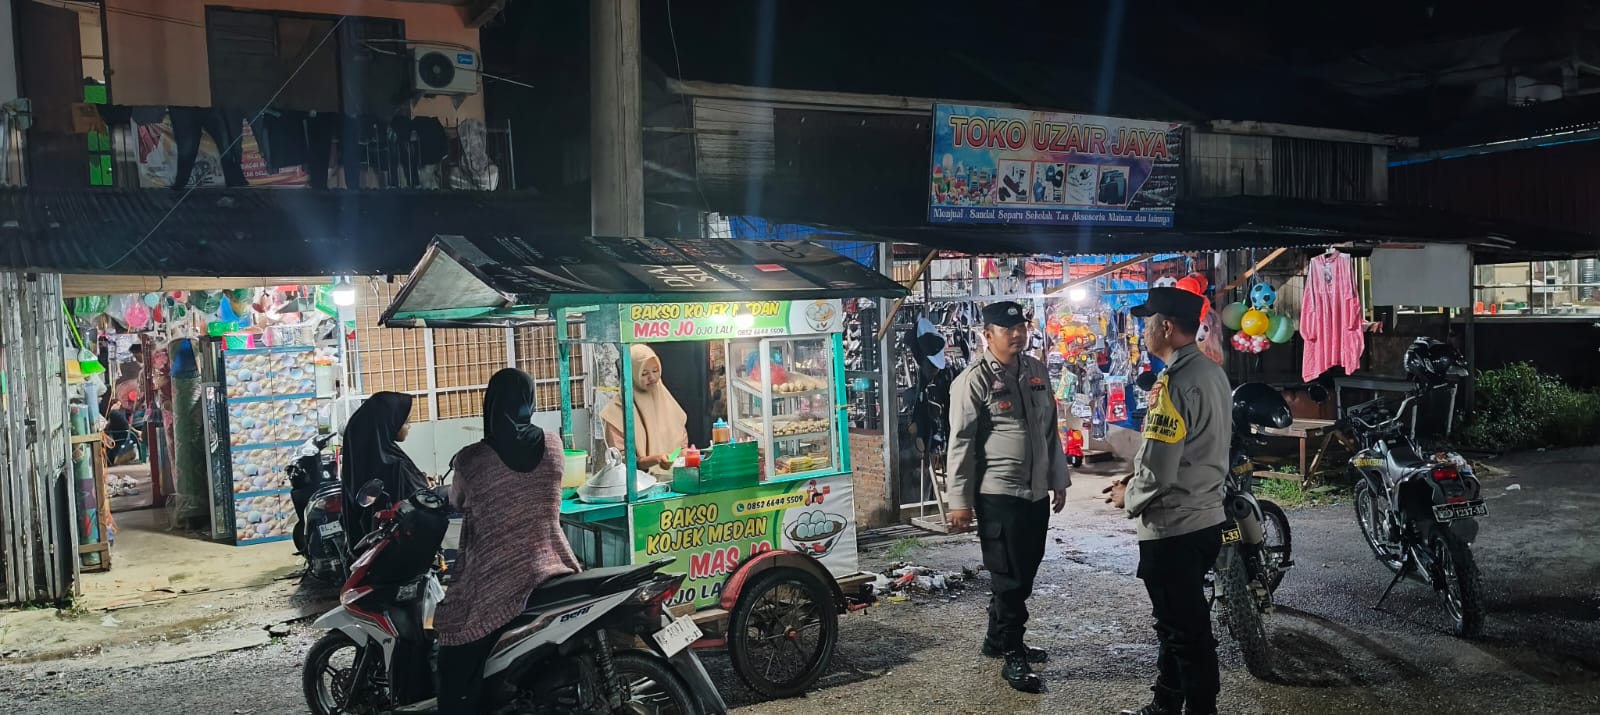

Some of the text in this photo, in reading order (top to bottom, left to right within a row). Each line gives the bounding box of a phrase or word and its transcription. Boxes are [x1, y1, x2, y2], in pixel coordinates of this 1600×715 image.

[950, 115, 1168, 159] TOKO UZAIR JAYA
[933, 208, 963, 222] Menjual
[969, 209, 996, 220] Sandal
[998, 209, 1024, 222] Sepatu
[1025, 210, 1053, 221] Sekolah
[1055, 211, 1069, 221] Tas
[1107, 212, 1133, 223] Mainan
[1134, 212, 1147, 223] dan
[631, 303, 681, 321] BAKSO
[683, 303, 732, 319] KOJEK
[633, 322, 670, 339] MAS
[674, 321, 696, 337] JO
[695, 326, 713, 336] OJO
[746, 495, 804, 510] 0852 6644 5509
[660, 503, 718, 531] BAKSO
[646, 516, 768, 555] KOJEK MEDAN
[689, 546, 740, 580] MAS
